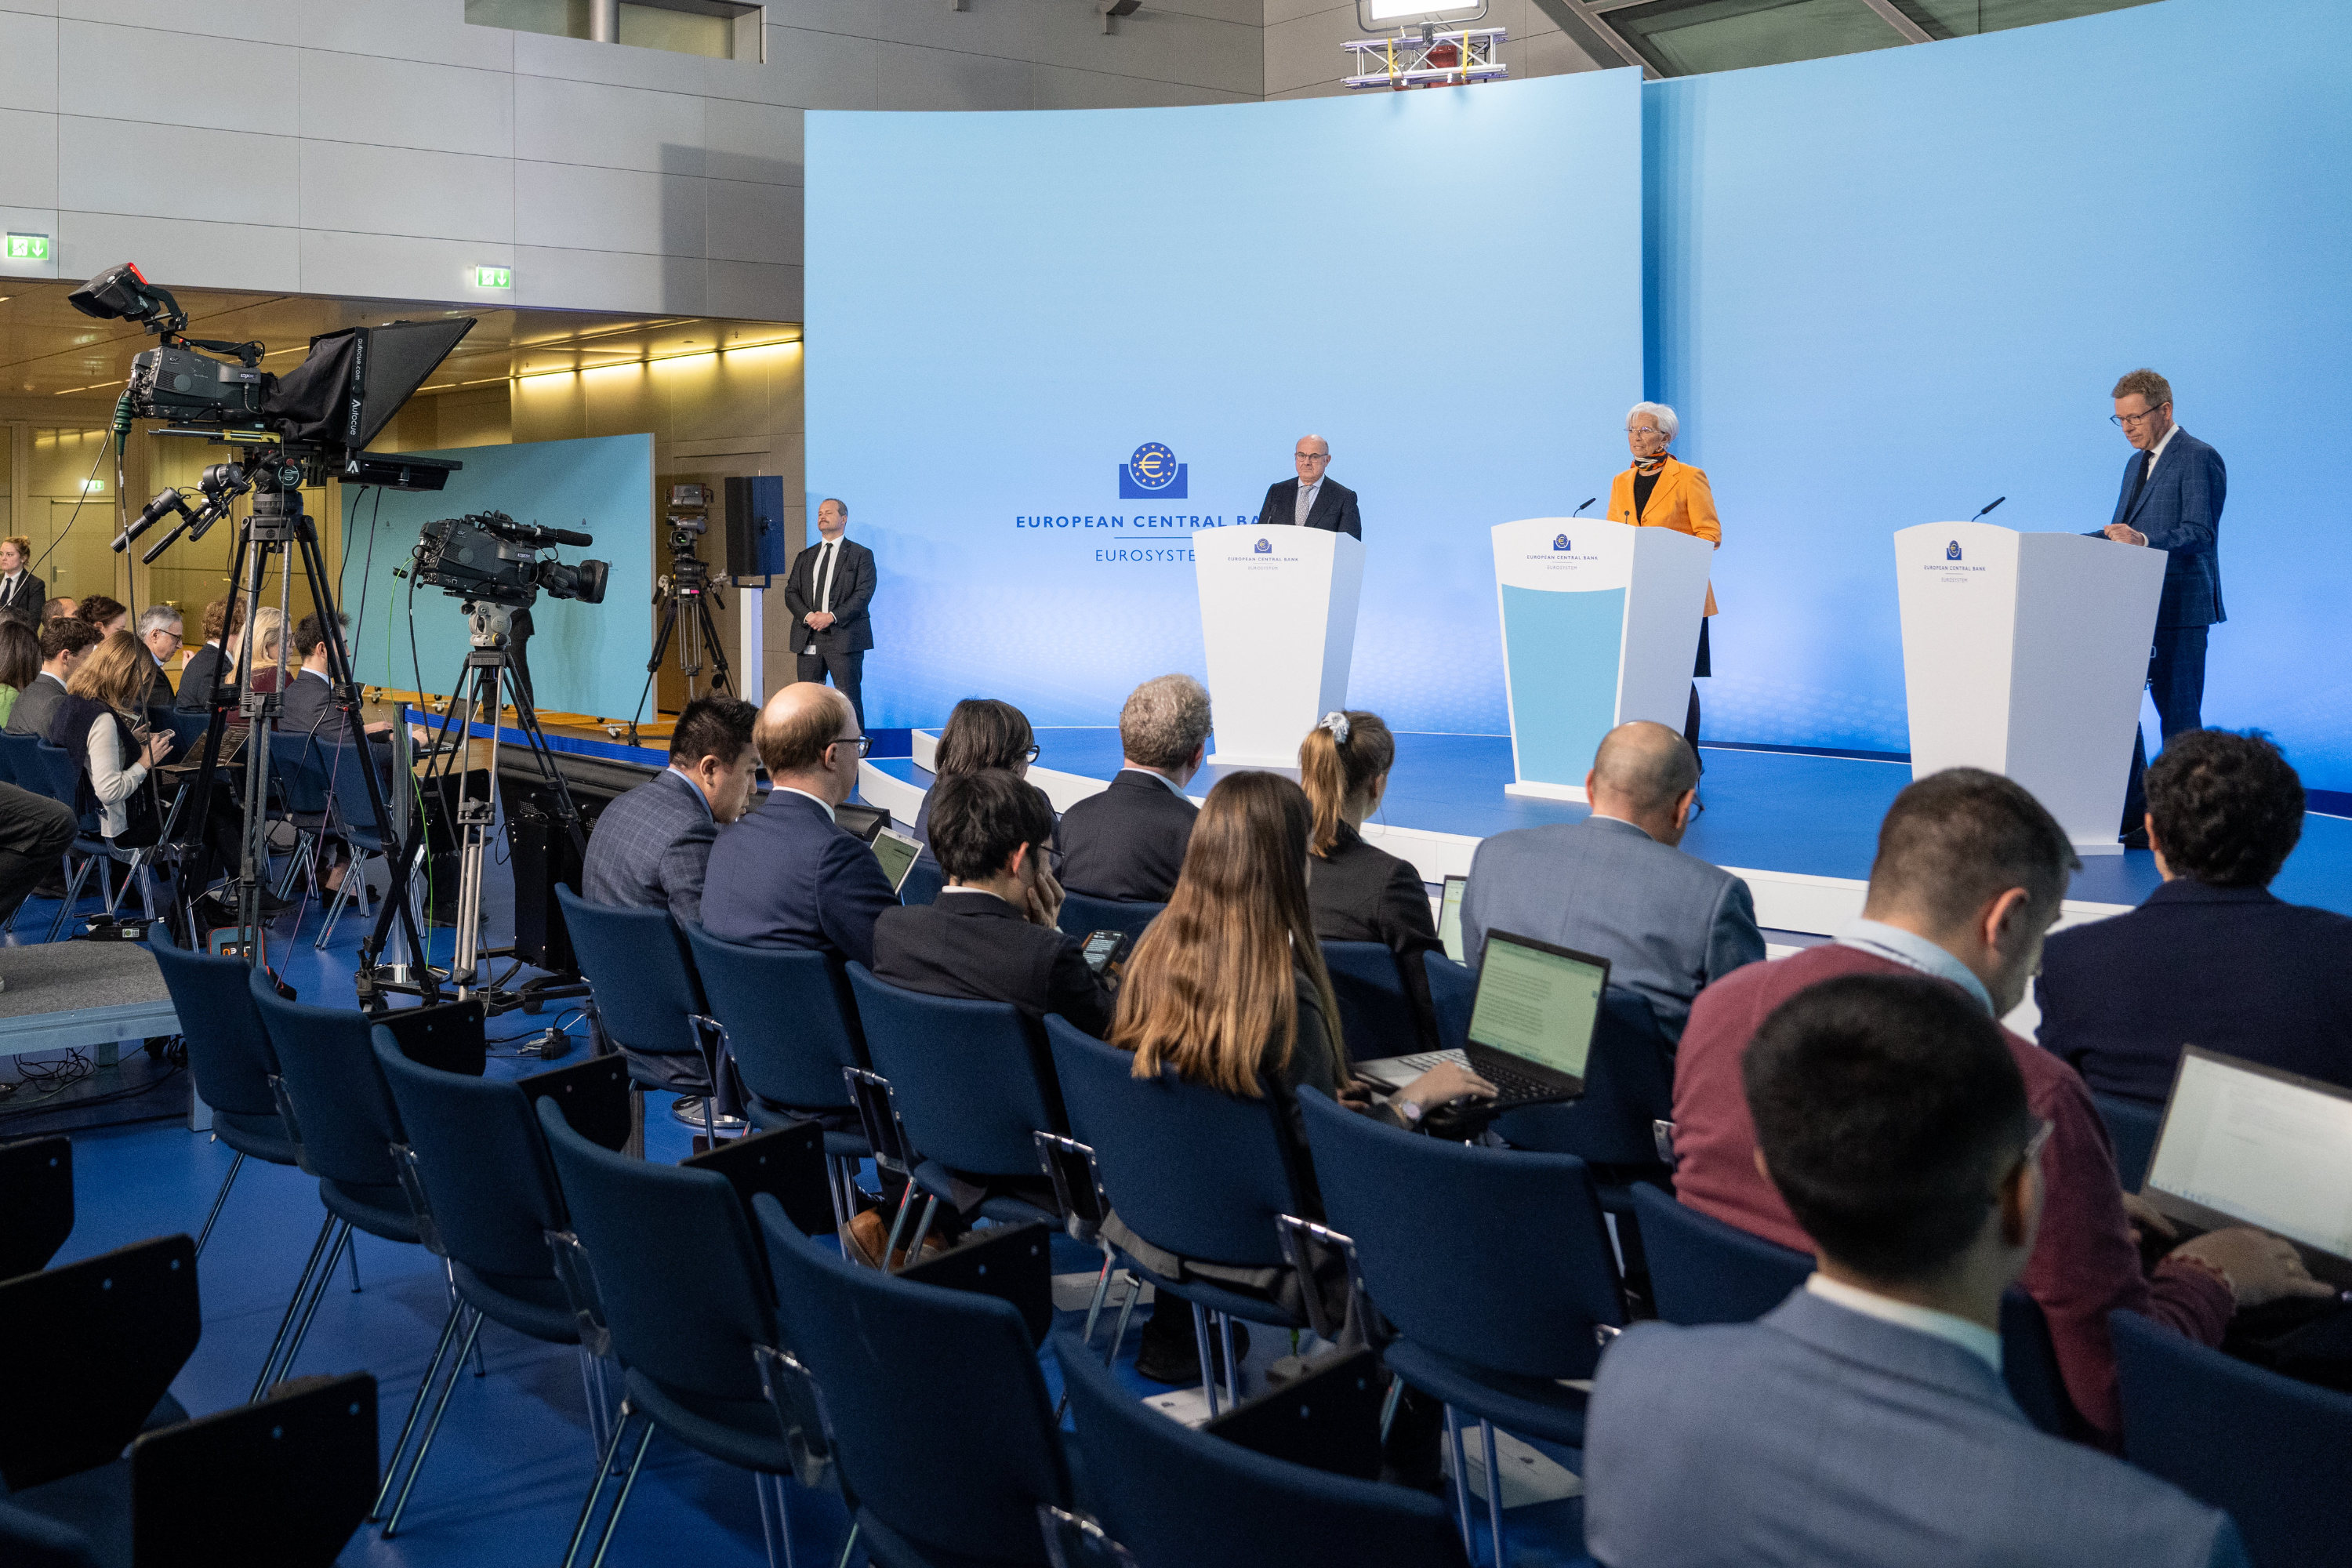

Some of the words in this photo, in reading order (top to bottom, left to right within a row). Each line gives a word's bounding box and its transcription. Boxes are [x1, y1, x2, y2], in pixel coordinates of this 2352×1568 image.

[350, 398, 361, 436] Autocue
[1016, 516, 1123, 528] EUROPEAN
[1133, 516, 1227, 528] CENTRAL
[1236, 515, 1260, 524] BA
[1095, 550, 1196, 561] EUROSYSTE
